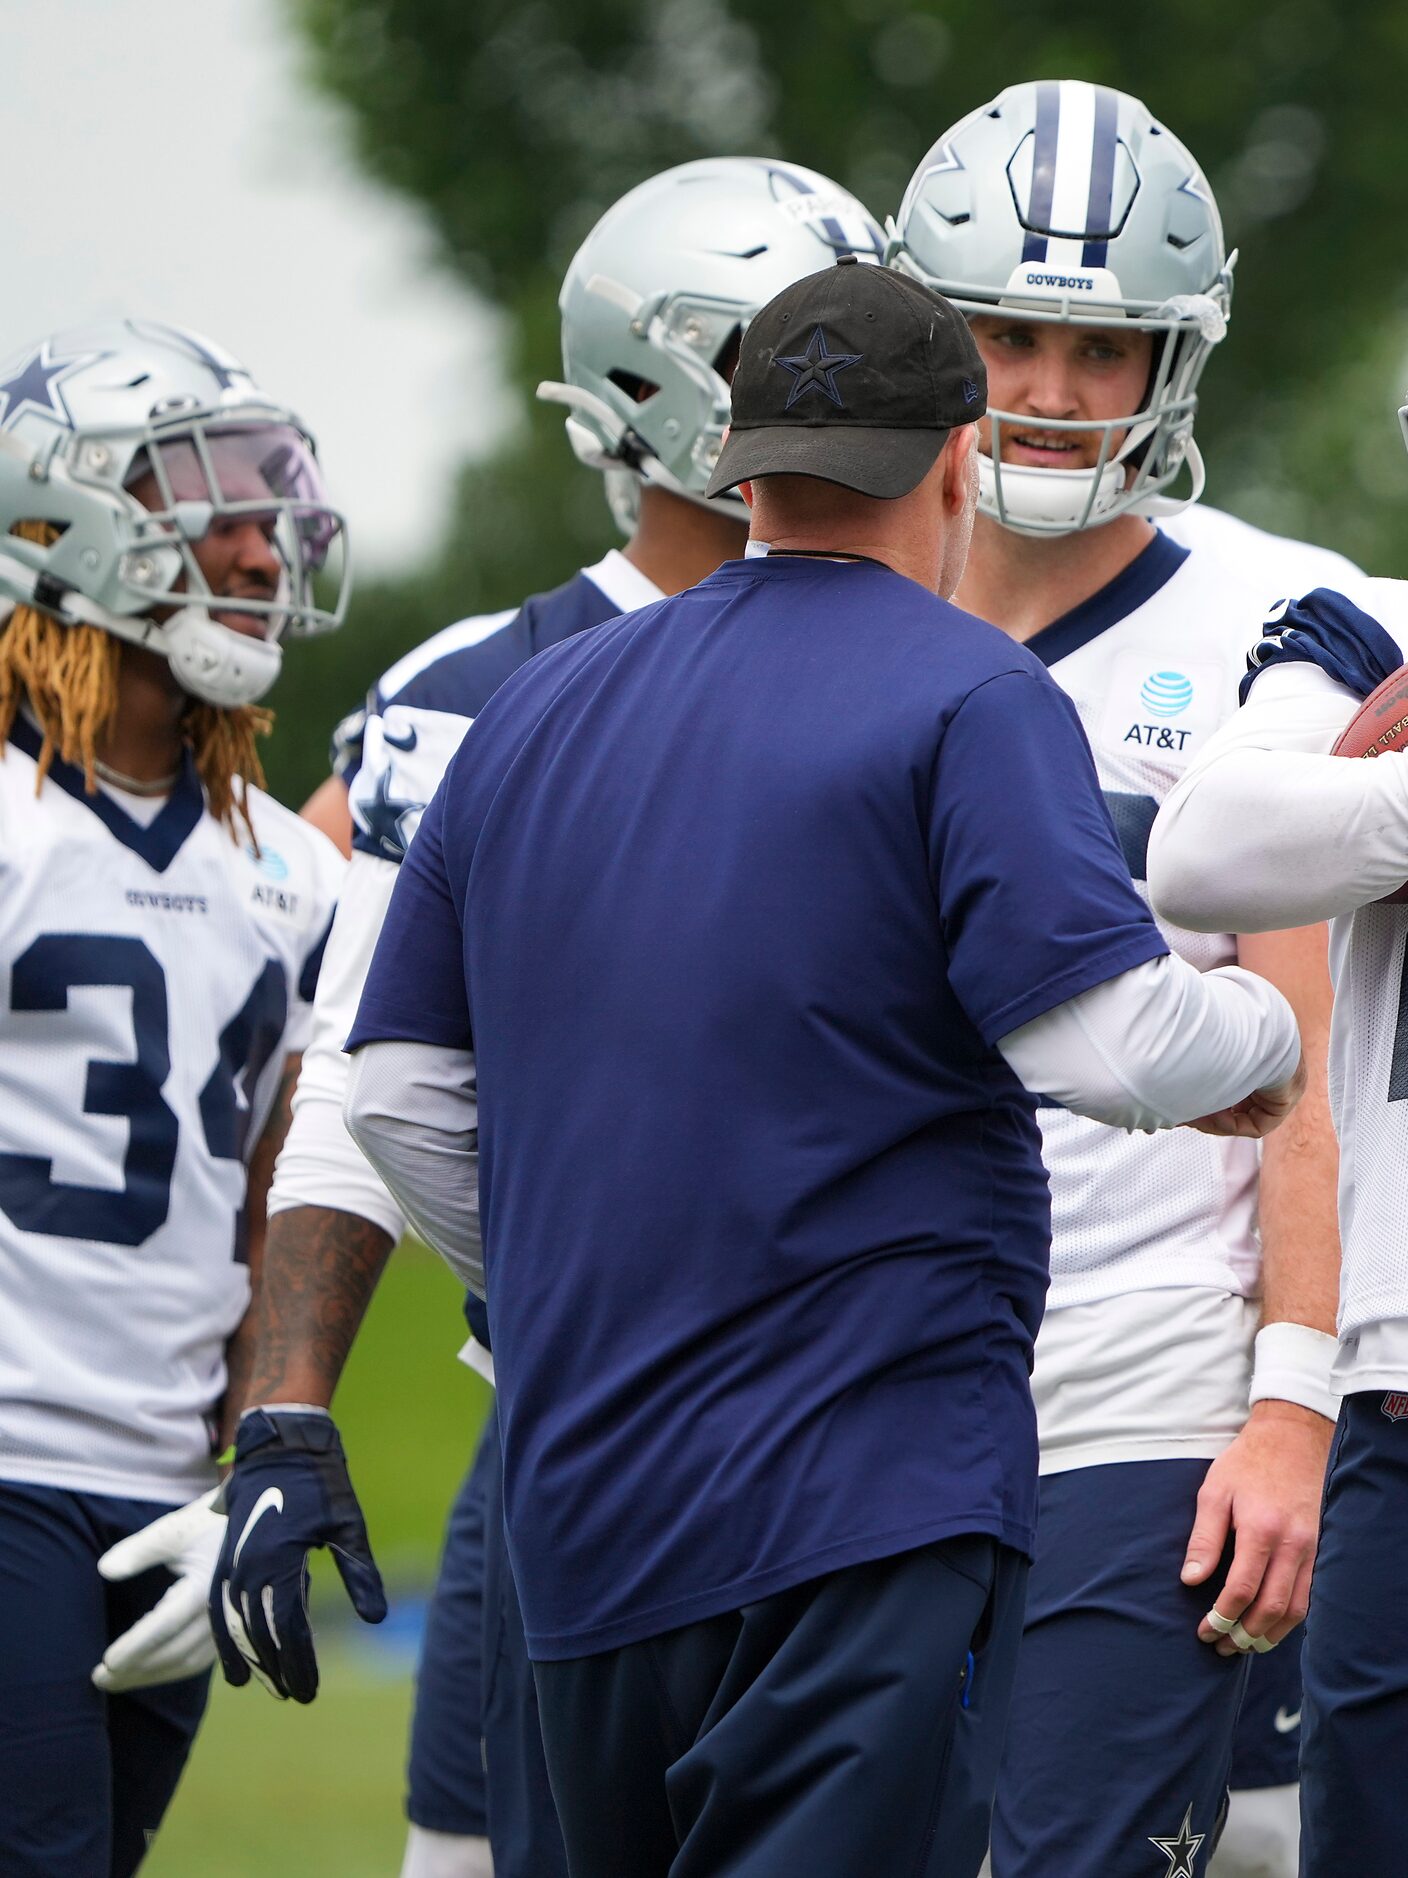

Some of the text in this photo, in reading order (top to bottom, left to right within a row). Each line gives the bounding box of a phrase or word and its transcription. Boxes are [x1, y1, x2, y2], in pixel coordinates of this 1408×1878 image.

[1026, 273, 1094, 290] COWBOYS
[1124, 723, 1192, 751] AT&T
[0, 932, 288, 1264] 34
